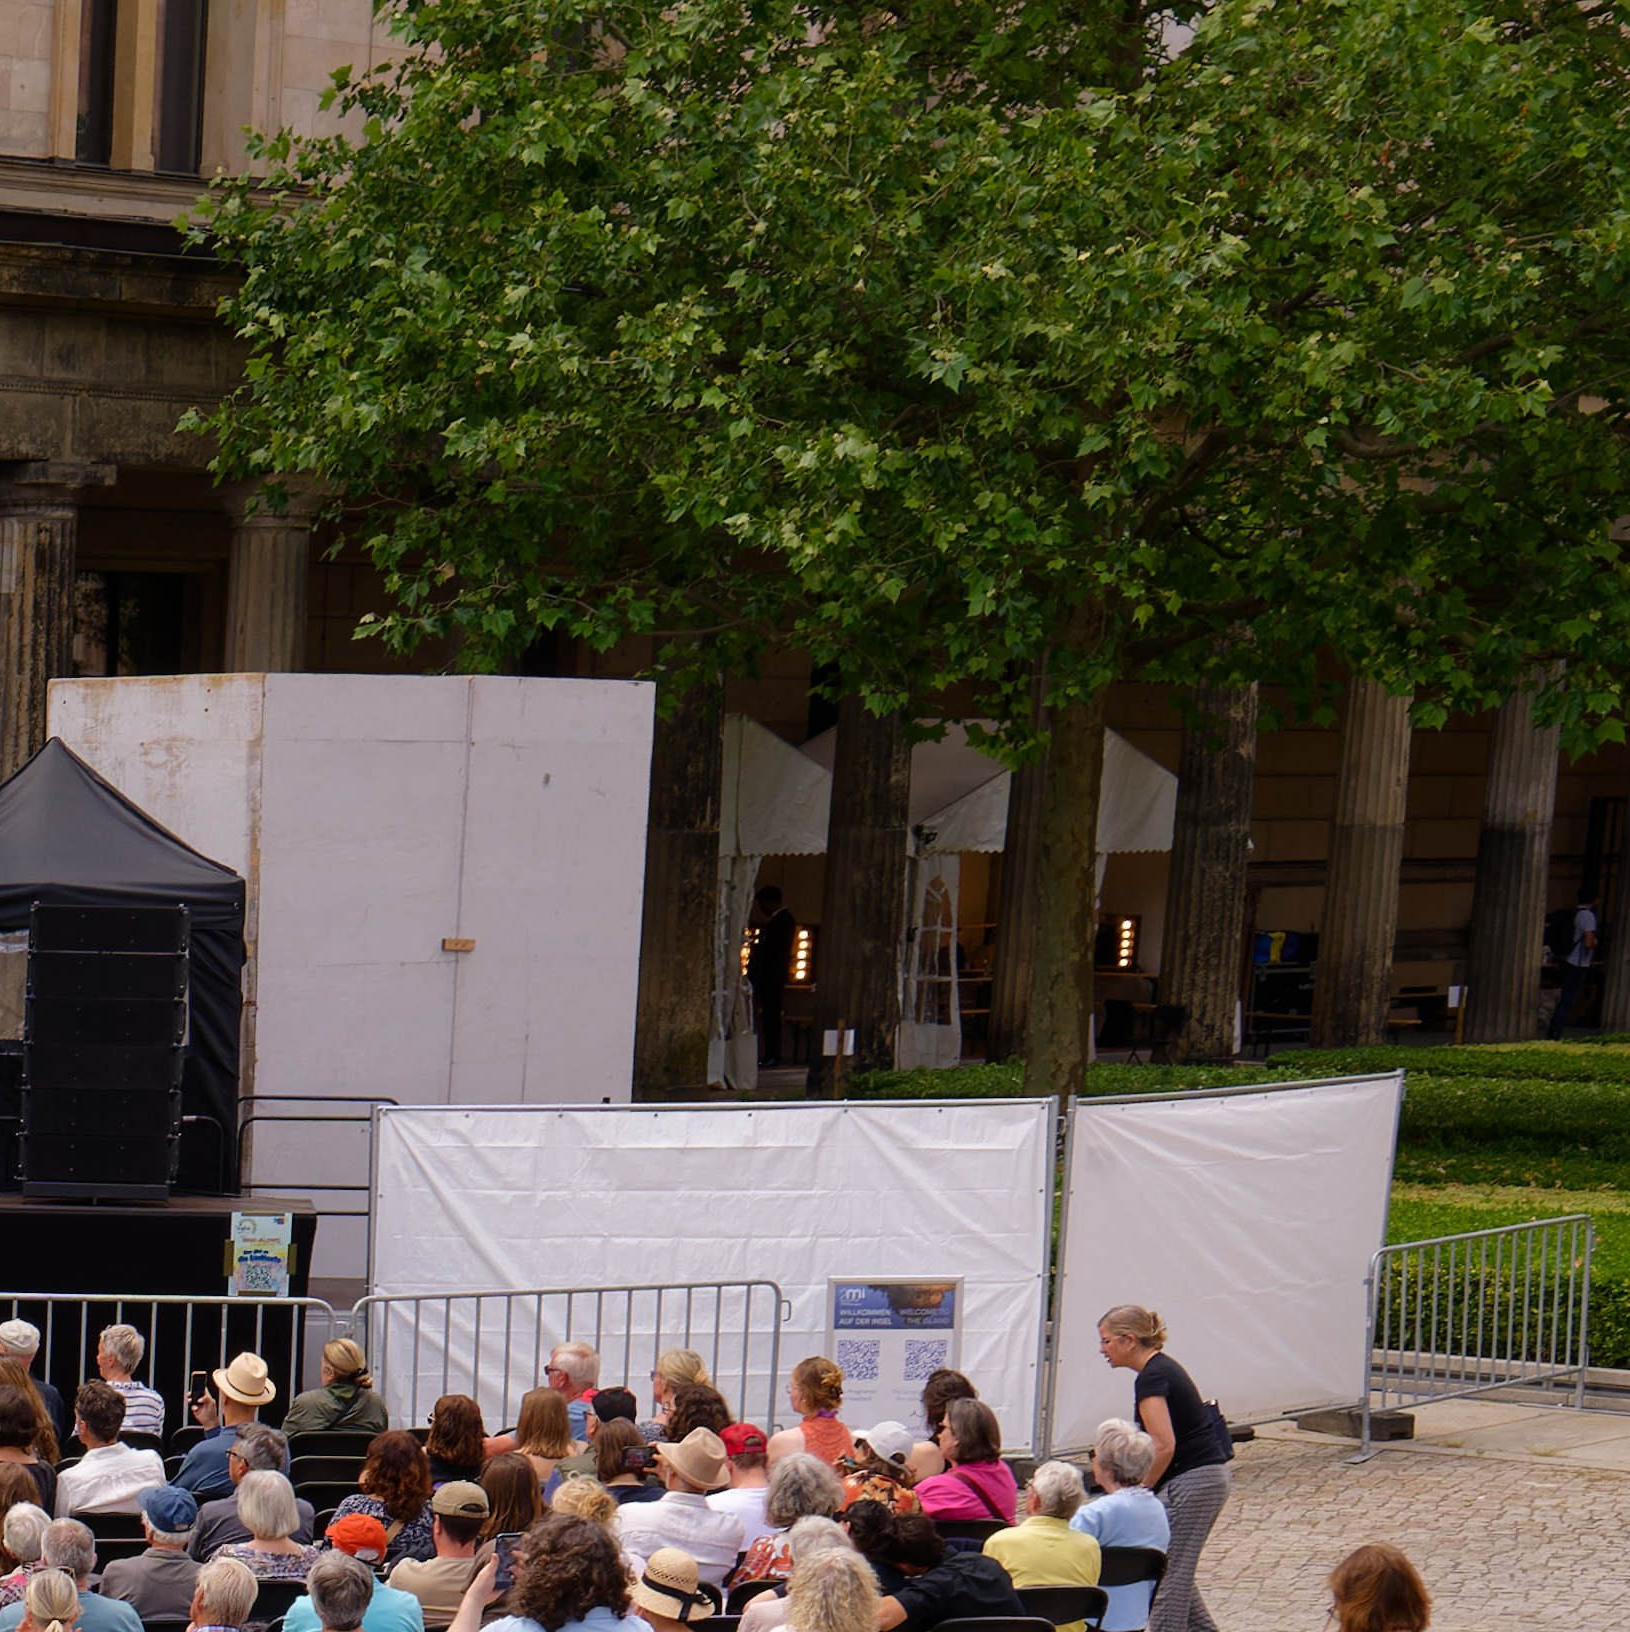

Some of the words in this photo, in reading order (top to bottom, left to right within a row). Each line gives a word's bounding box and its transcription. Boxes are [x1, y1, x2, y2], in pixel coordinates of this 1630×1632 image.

[839, 1308, 892, 1316] WILLKOMMEN
[838, 1317, 854, 1325] AUF
[854, 1317, 871, 1326] DER
[871, 1318, 893, 1326] INSEL
